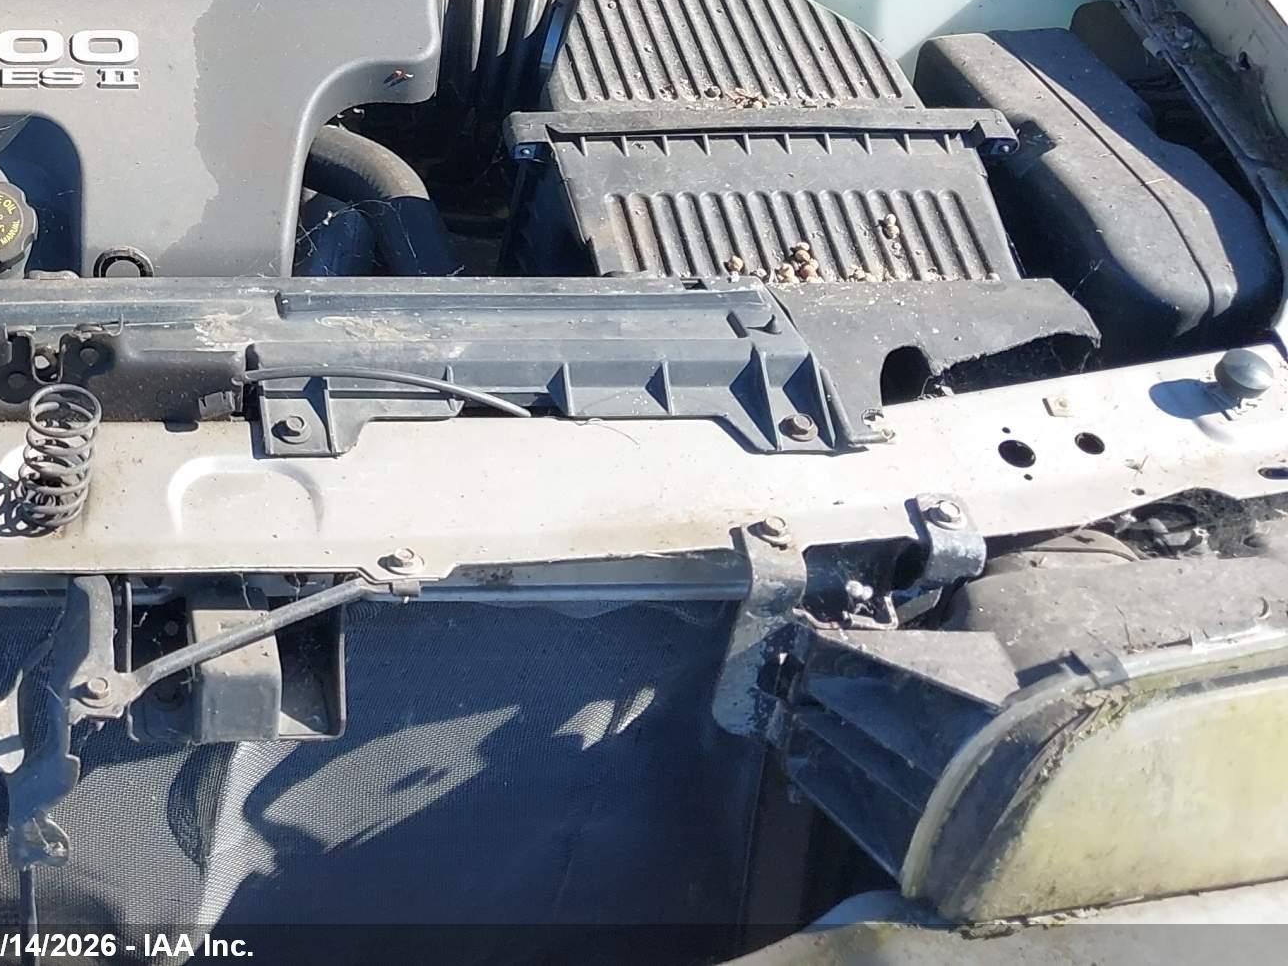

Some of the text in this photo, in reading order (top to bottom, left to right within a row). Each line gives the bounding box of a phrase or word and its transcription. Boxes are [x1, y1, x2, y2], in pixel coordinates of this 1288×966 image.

[96, 67, 140, 90] II
[2, 199, 17, 215] OIL
[0, 219, 20, 246] MANUAL
